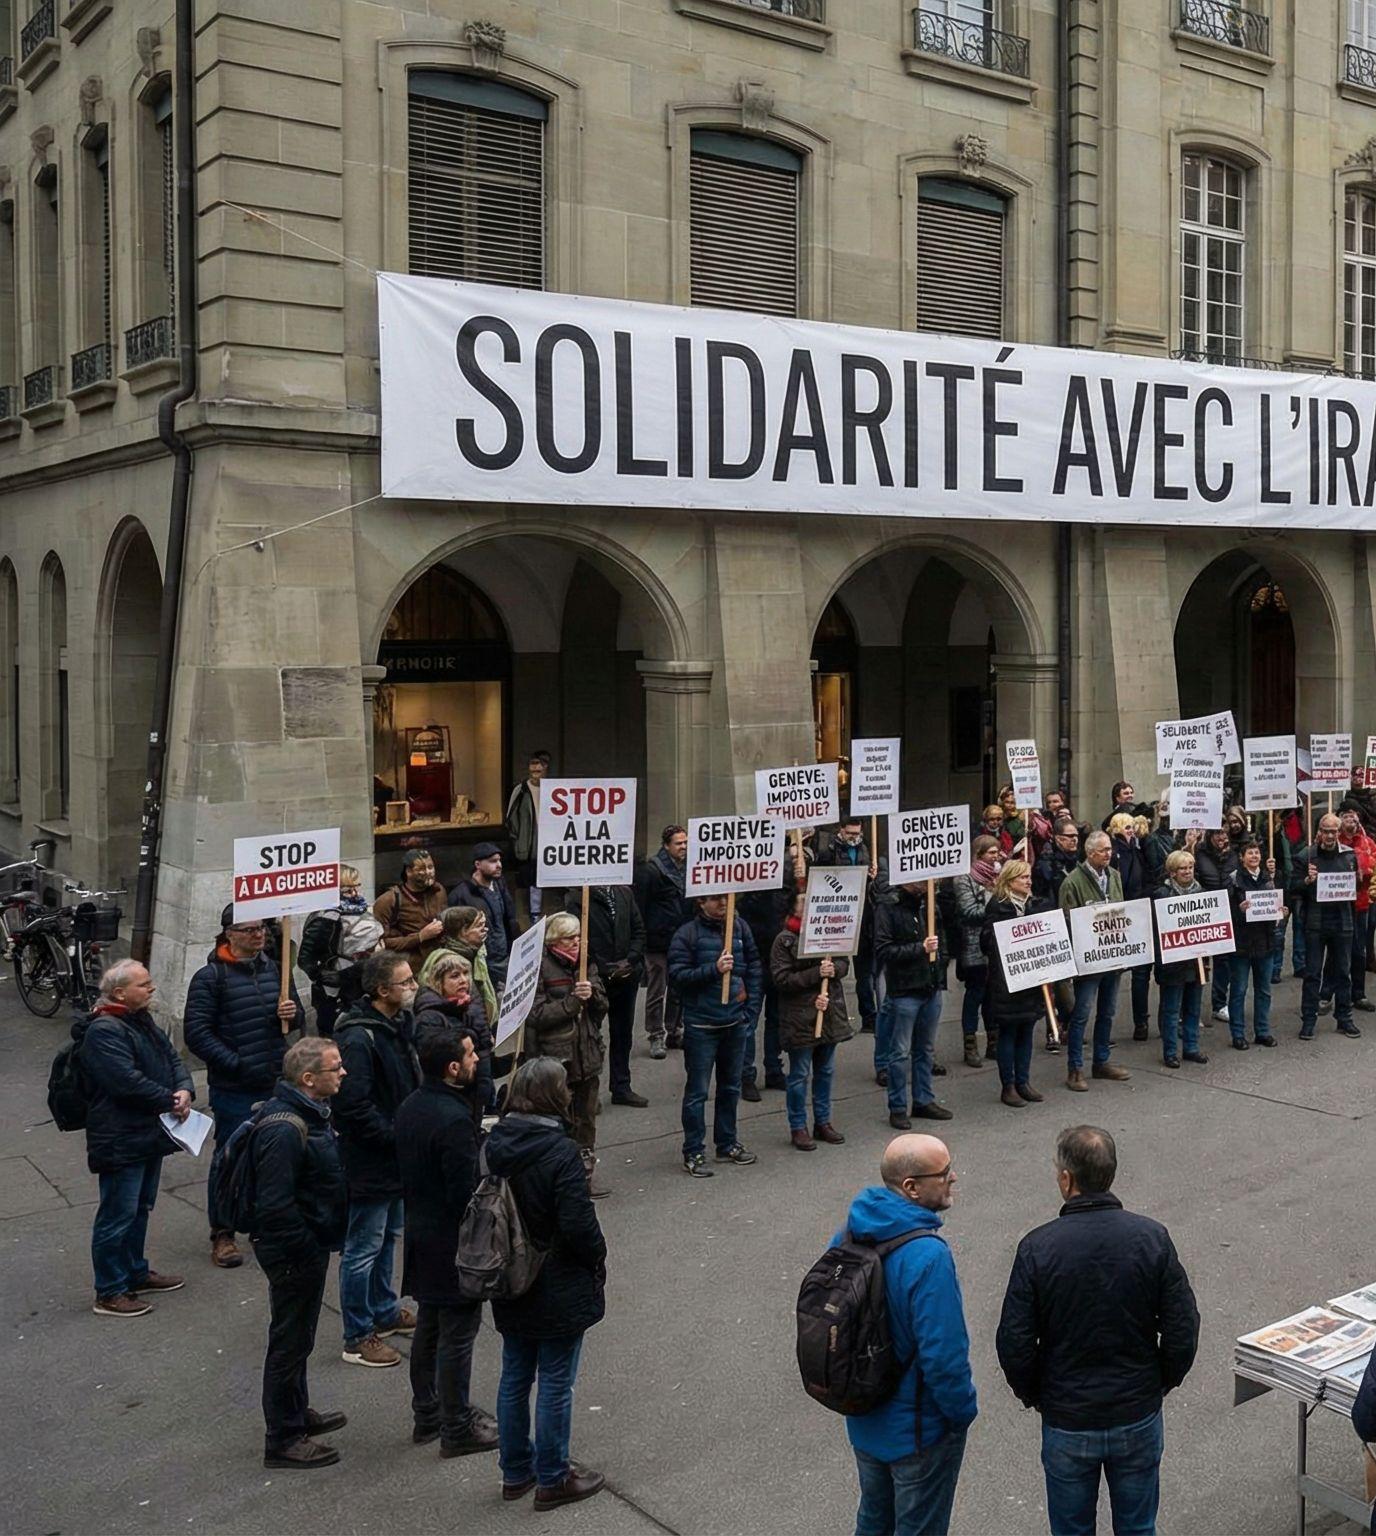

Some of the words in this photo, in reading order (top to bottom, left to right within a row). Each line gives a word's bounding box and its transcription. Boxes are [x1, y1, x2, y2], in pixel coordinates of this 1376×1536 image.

[455, 315, 1024, 493] SOLIDARITÉ
[1052, 374, 1233, 503] AVEC
[550, 787, 626, 815] STOP
[813, 786, 829, 800] OU
[563, 815, 577, 841] À
[585, 820, 611, 841] LA
[698, 816, 776, 843] GENÈVE:
[902, 811, 958, 834] GENÈVE:
[754, 842, 774, 858] OU
[947, 831, 964, 847] OU
[259, 841, 317, 869] STOP
[543, 843, 629, 866] GUERRE
[900, 849, 962, 872] ETHIQUE?
[238, 873, 250, 898] À
[254, 876, 273, 895] LA
[276, 868, 335, 892] GUERRE
[691, 860, 779, 886] ÉTHIQUE?
[1173, 932, 1186, 946] LA
[1187, 926, 1227, 943] GUERRE
